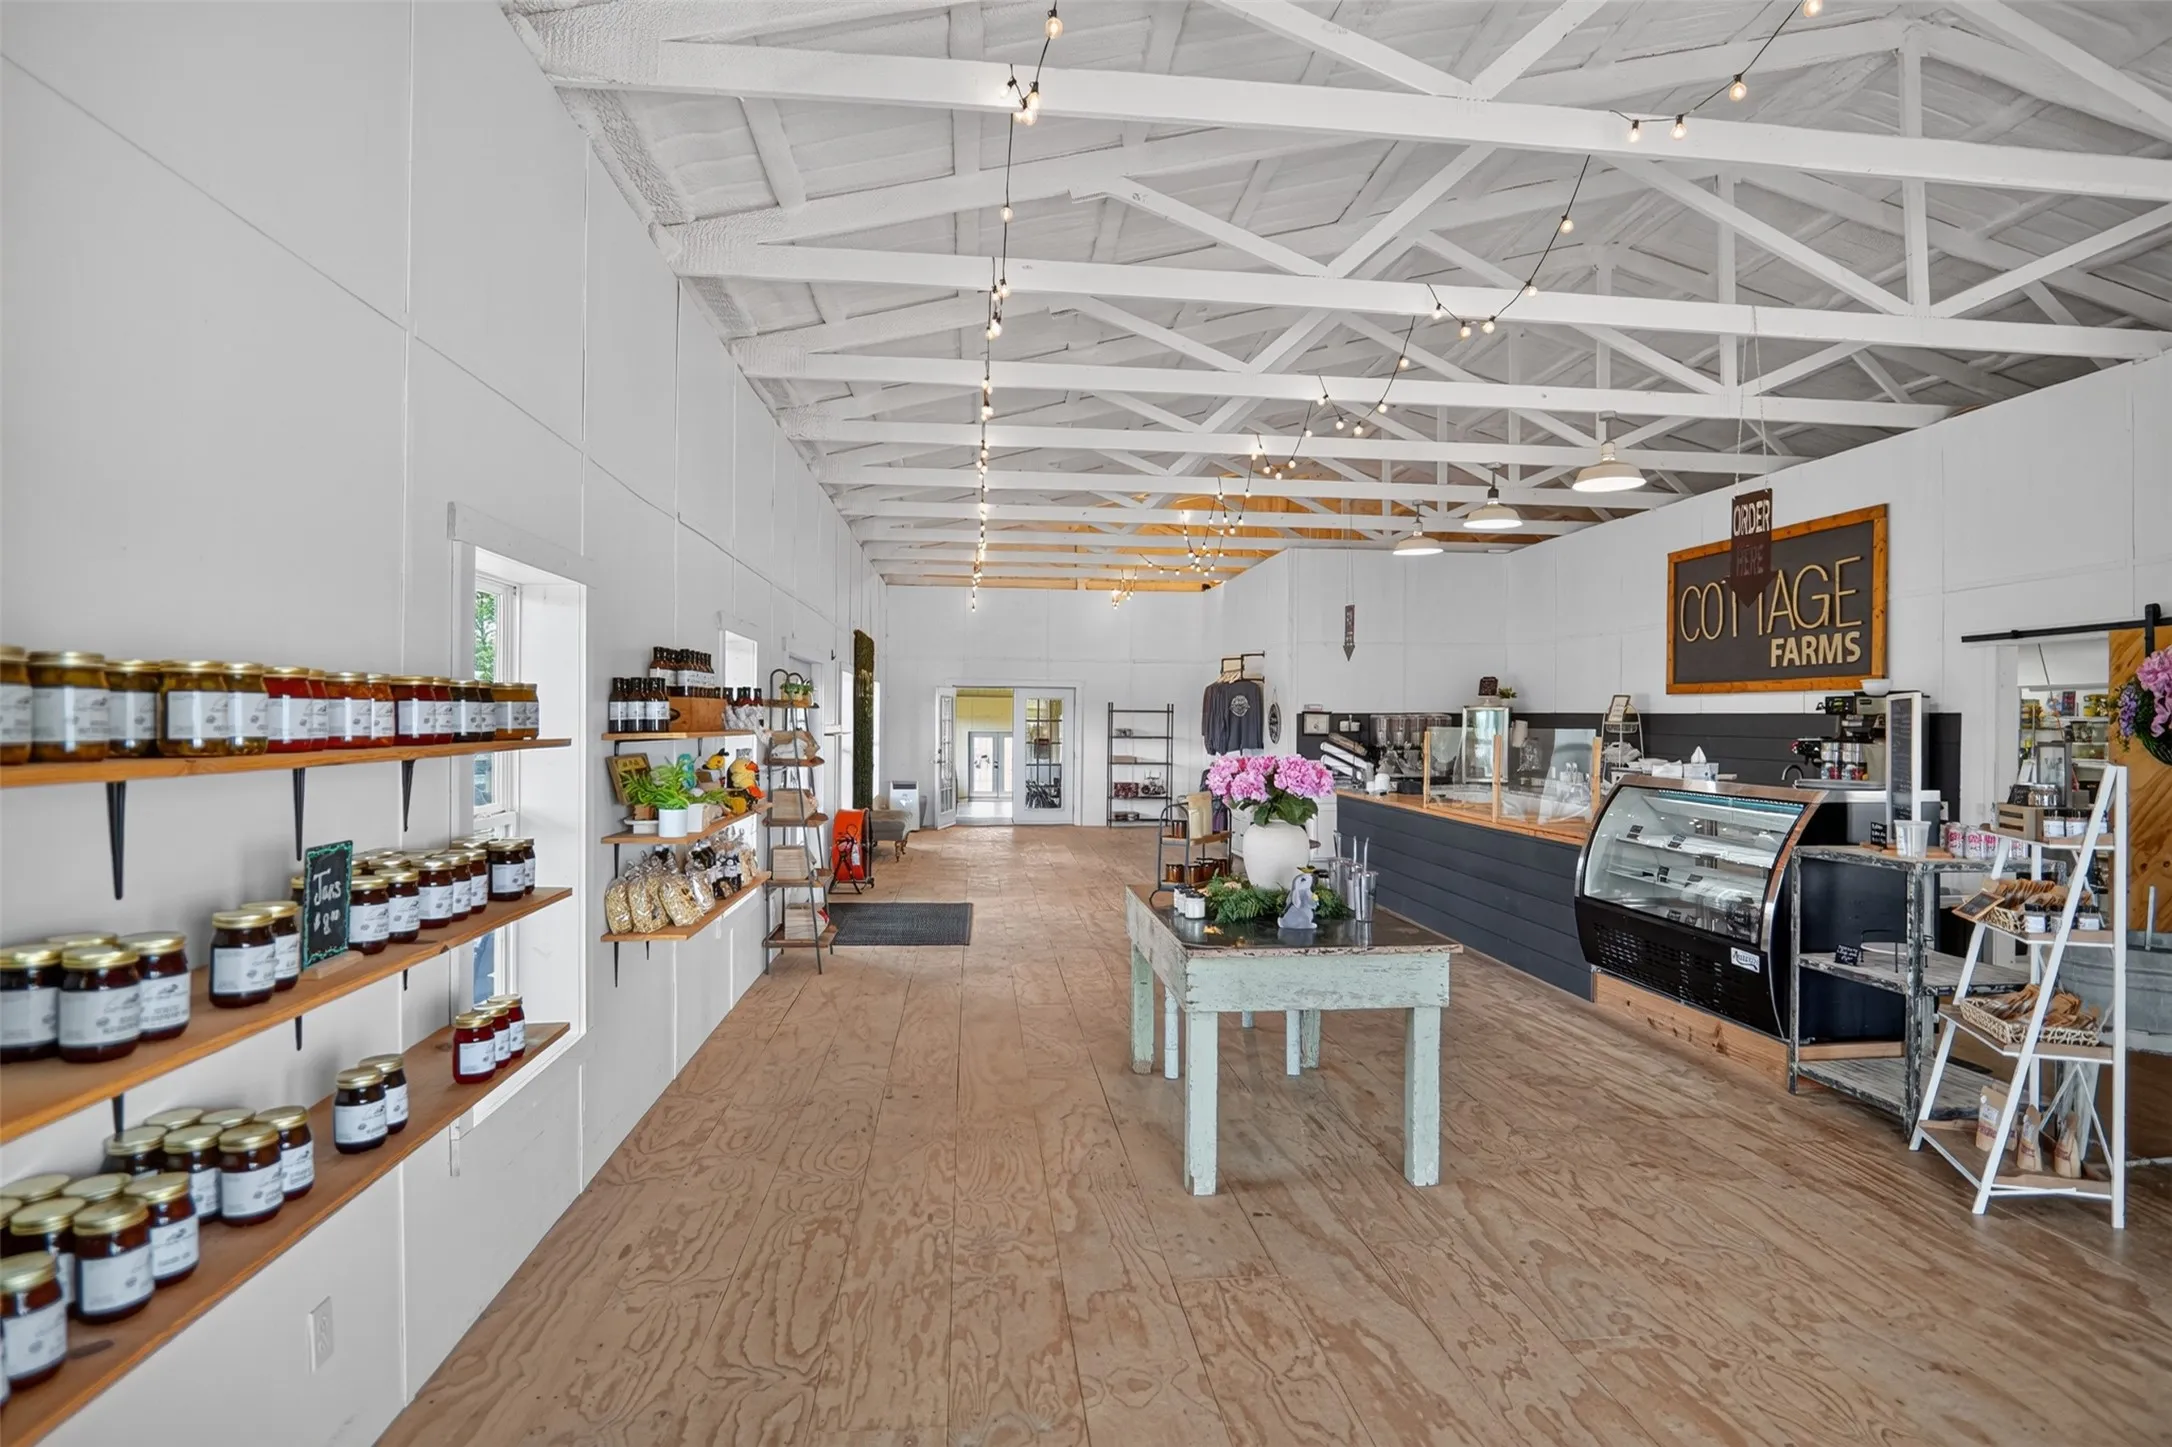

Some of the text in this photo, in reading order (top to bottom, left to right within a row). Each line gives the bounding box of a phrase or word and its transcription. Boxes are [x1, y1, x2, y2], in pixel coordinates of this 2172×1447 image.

[1733, 500, 1770, 536] ORDER
[1736, 544, 1764, 577] HERE
[1771, 631, 1861, 667] FARMS
